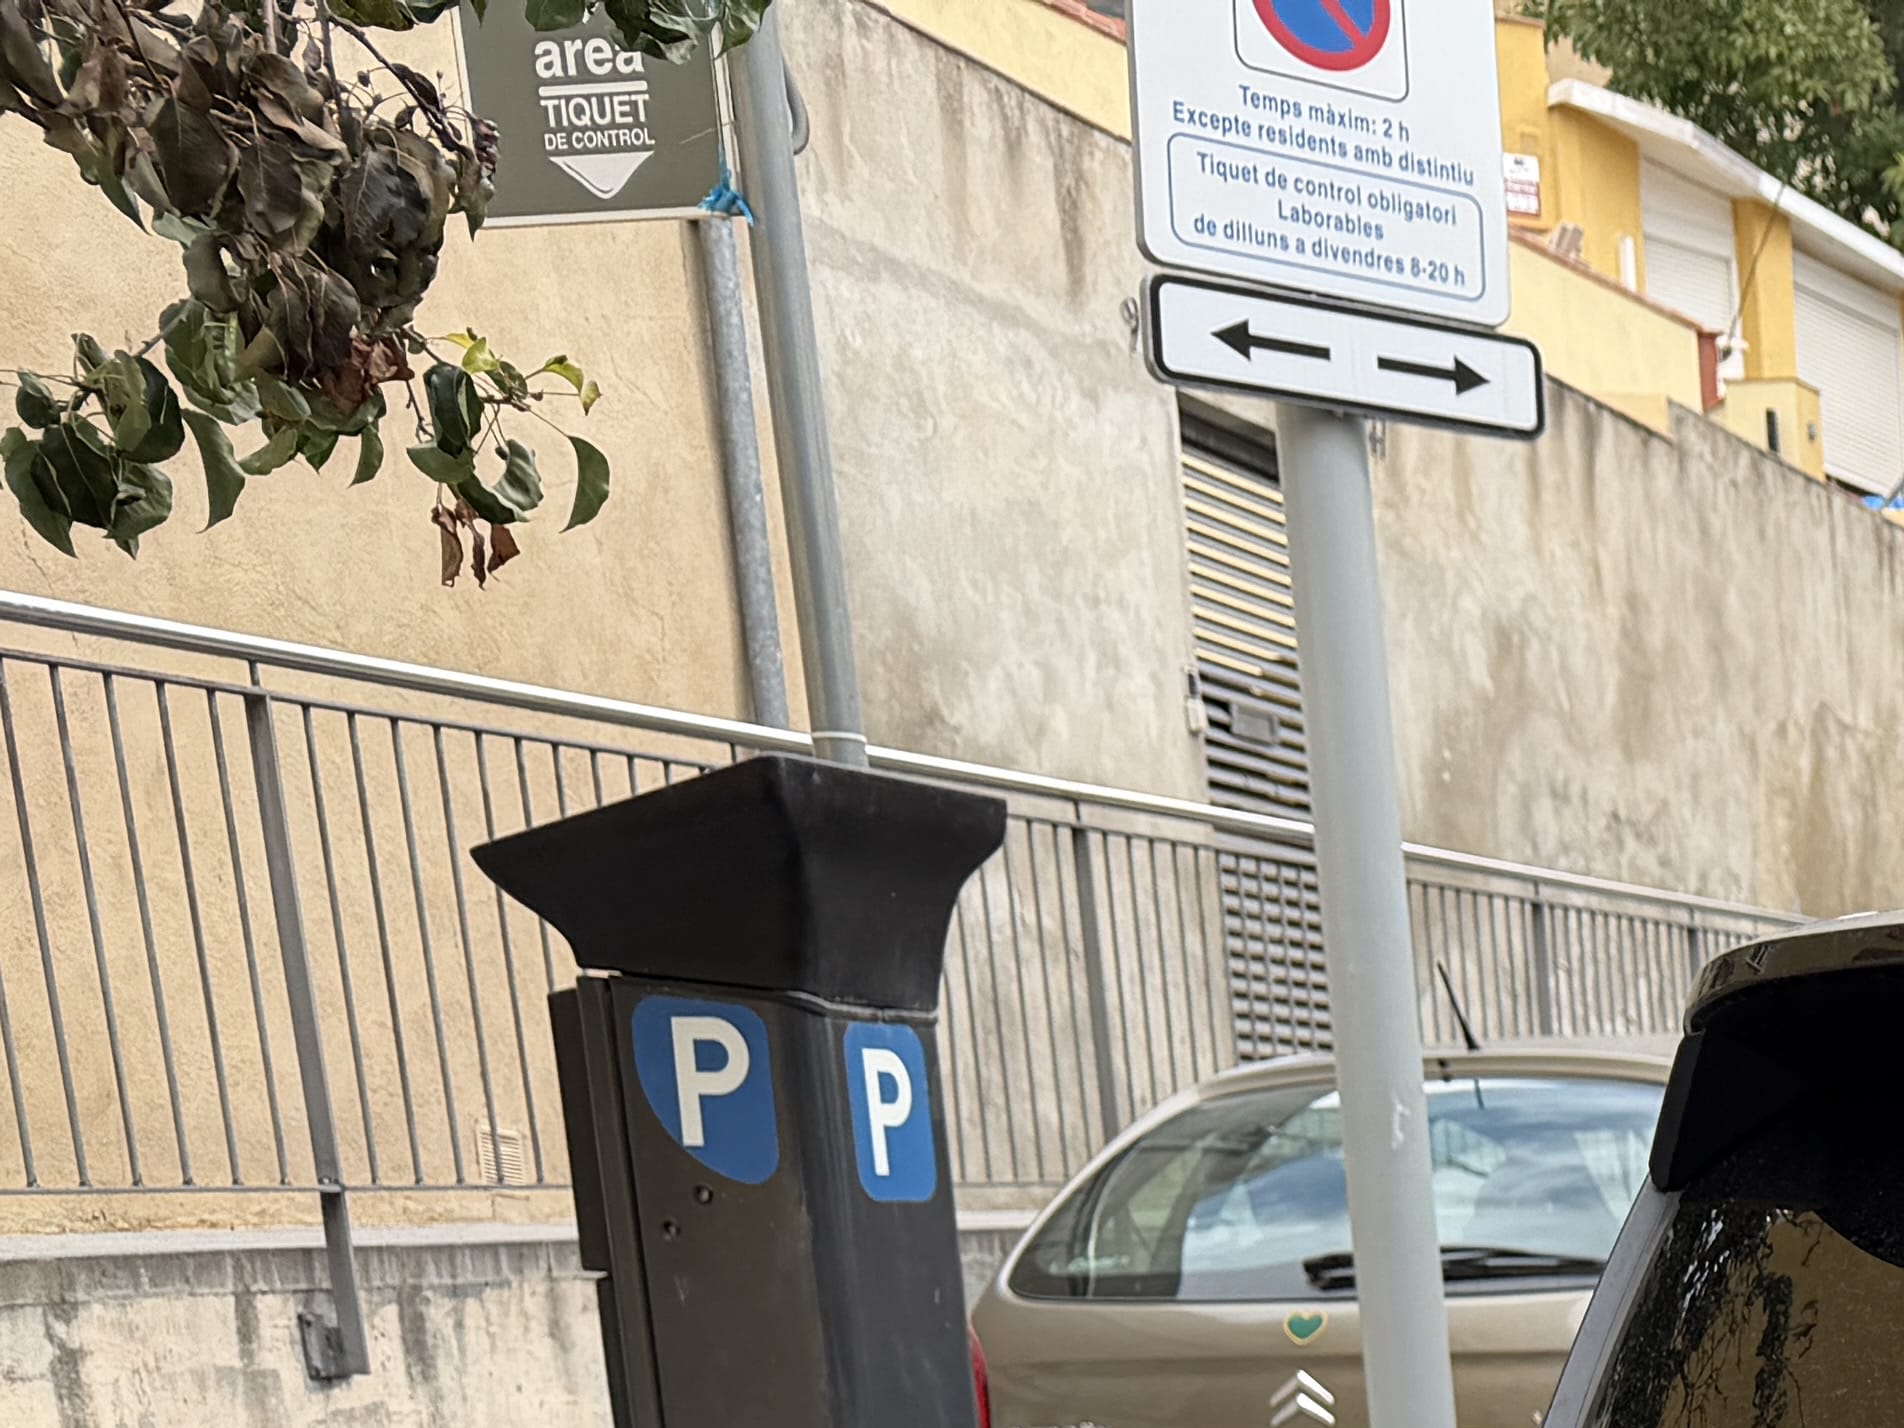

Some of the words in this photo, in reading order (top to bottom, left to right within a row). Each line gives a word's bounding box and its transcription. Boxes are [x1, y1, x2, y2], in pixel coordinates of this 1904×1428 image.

[534, 37, 645, 78] area
[540, 93, 649, 128] TIQUET
[544, 133, 568, 150] DE
[572, 128, 656, 149] CONTROL
[1172, 100, 1251, 137] Excepte
[1258, 122, 1347, 158] residents
[1354, 142, 1393, 168] amb
[1399, 151, 1475, 186] distintiu
[1239, 84, 1302, 118] Temps
[1309, 103, 1377, 135] màxim:
[1382, 118, 1393, 139] 2
[1399, 121, 1410, 142] h
[1196, 151, 1259, 184] Tiquet
[1265, 167, 1287, 190] de
[1294, 175, 1361, 206] control
[1368, 190, 1456, 226] obligatori
[1278, 199, 1384, 240] Laborables
[1194, 213, 1217, 236] de
[1223, 219, 1289, 251] dilluns
[1295, 236, 1306, 254] a
[1311, 237, 1405, 275] divendres
[1410, 256, 1449, 283] 8-20
[1454, 264, 1465, 287] h
[670, 1016, 750, 1147] P
[861, 1047, 913, 1177] P
